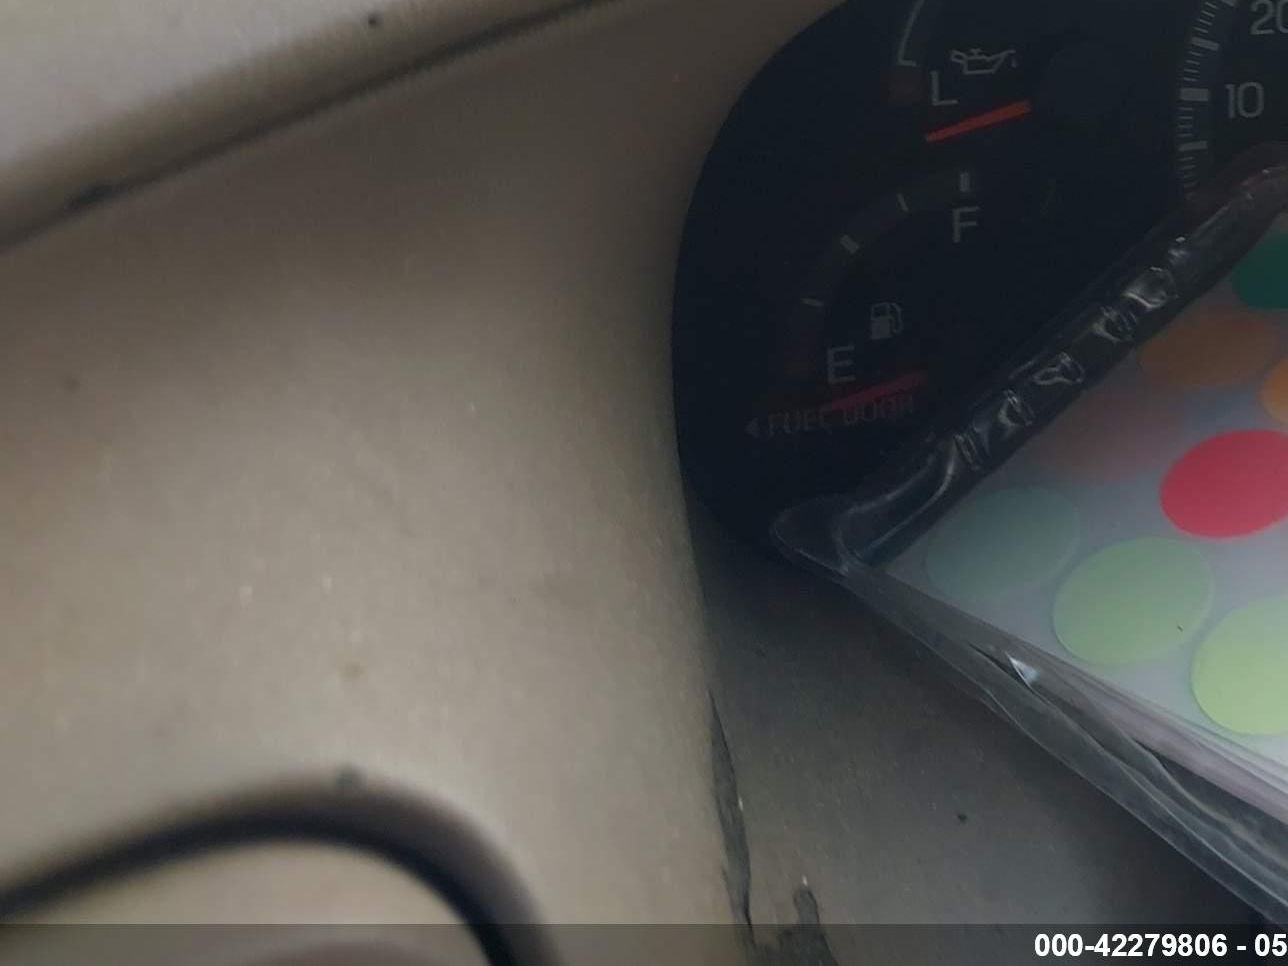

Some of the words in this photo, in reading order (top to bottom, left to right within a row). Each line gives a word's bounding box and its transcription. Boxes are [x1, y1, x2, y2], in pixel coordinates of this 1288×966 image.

[930, 70, 958, 106] L
[1225, 82, 1264, 118] 10
[952, 206, 979, 243] F
[826, 345, 855, 384] E
